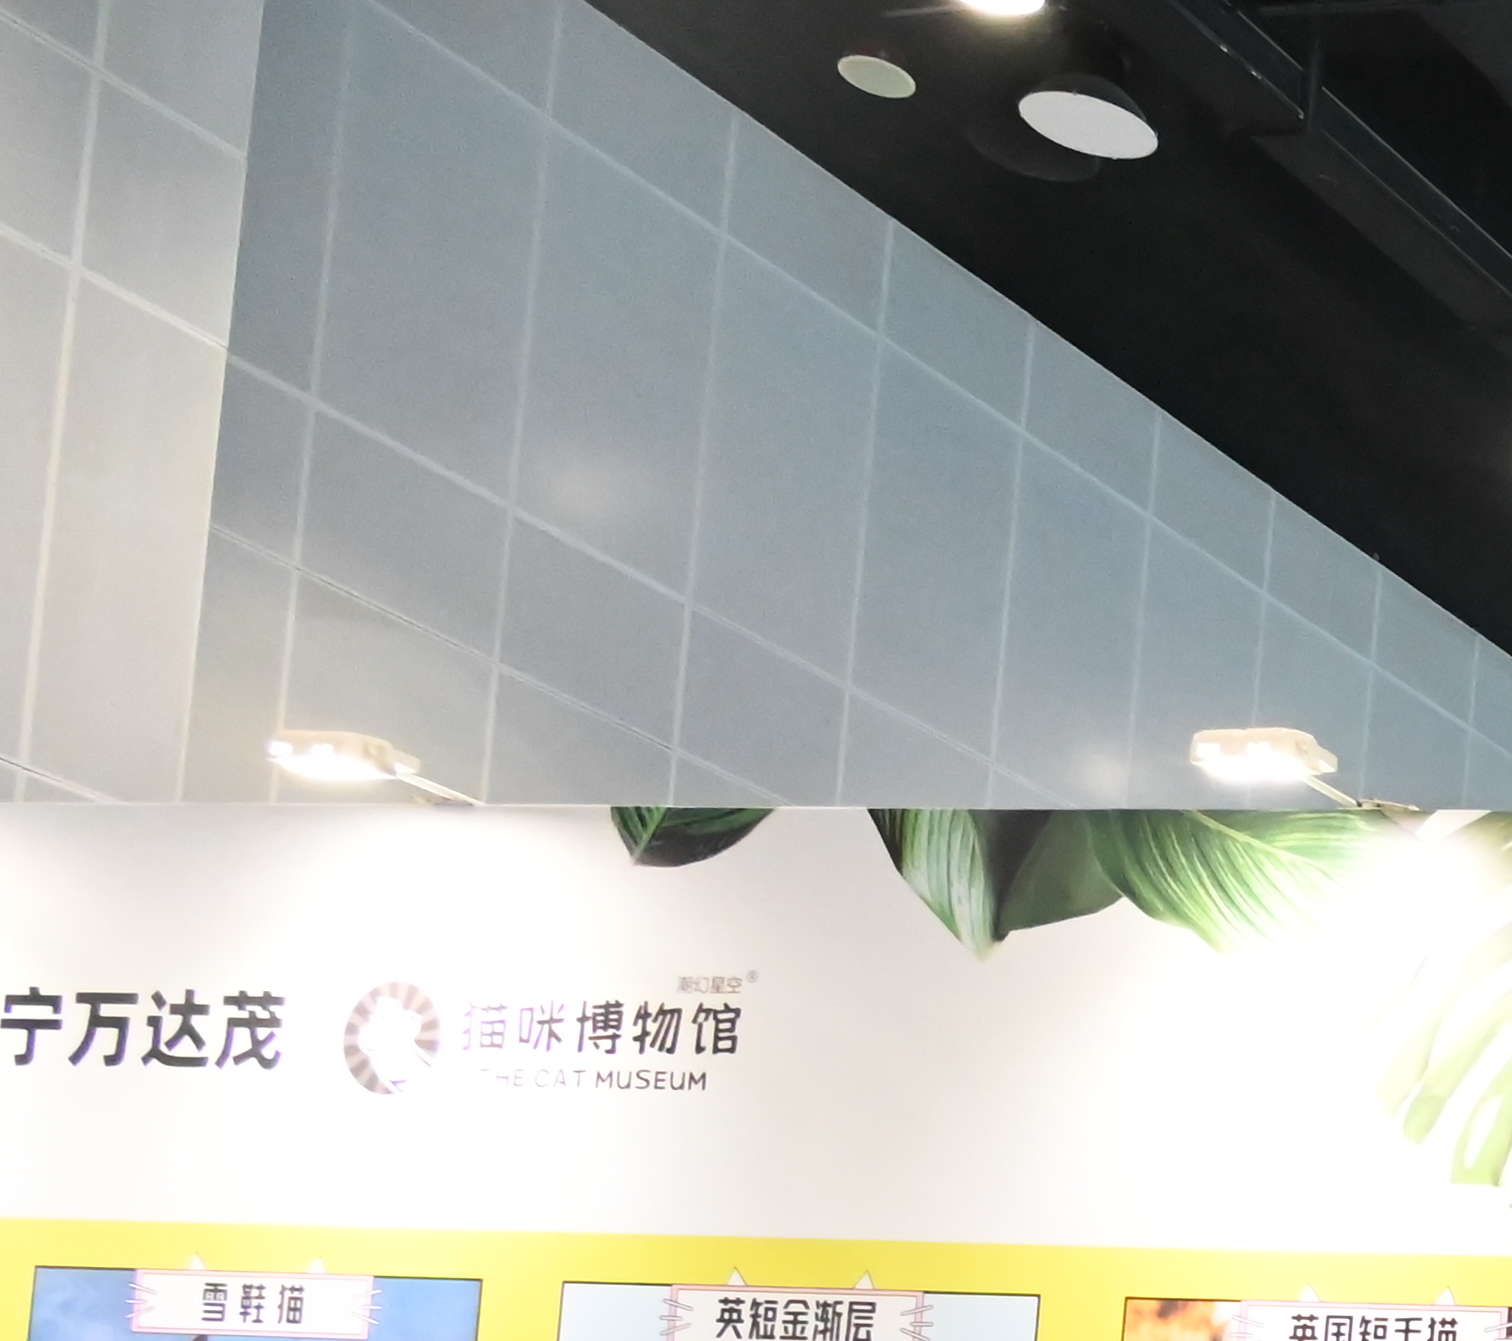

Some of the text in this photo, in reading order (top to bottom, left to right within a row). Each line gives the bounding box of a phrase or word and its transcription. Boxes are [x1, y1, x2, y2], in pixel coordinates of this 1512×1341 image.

[2, 990, 286, 1070] 宁万达茂
[463, 1001, 741, 1056] 猫咪博物馆
[534, 1068, 587, 1090] CAT
[595, 1068, 708, 1092] MUSEUM
[200, 1282, 305, 1325] 雪鞋猫
